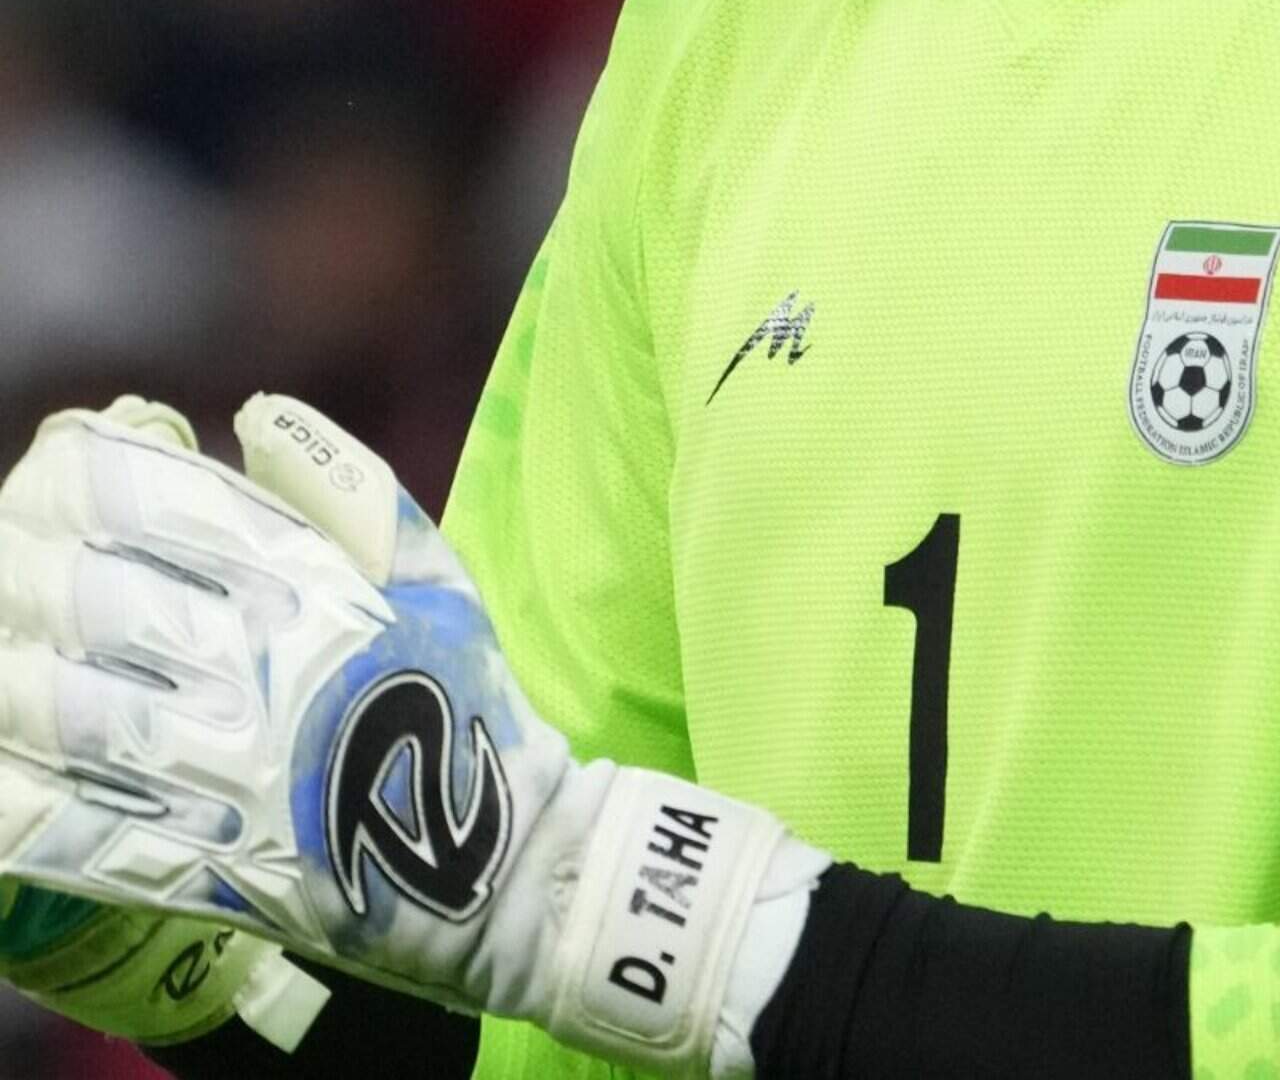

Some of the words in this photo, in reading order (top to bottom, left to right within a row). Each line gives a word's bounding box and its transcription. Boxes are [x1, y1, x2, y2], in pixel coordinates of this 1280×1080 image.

[882, 512, 961, 864] 1
[628, 804, 720, 929] TAHA
[608, 950, 677, 1007] D.
